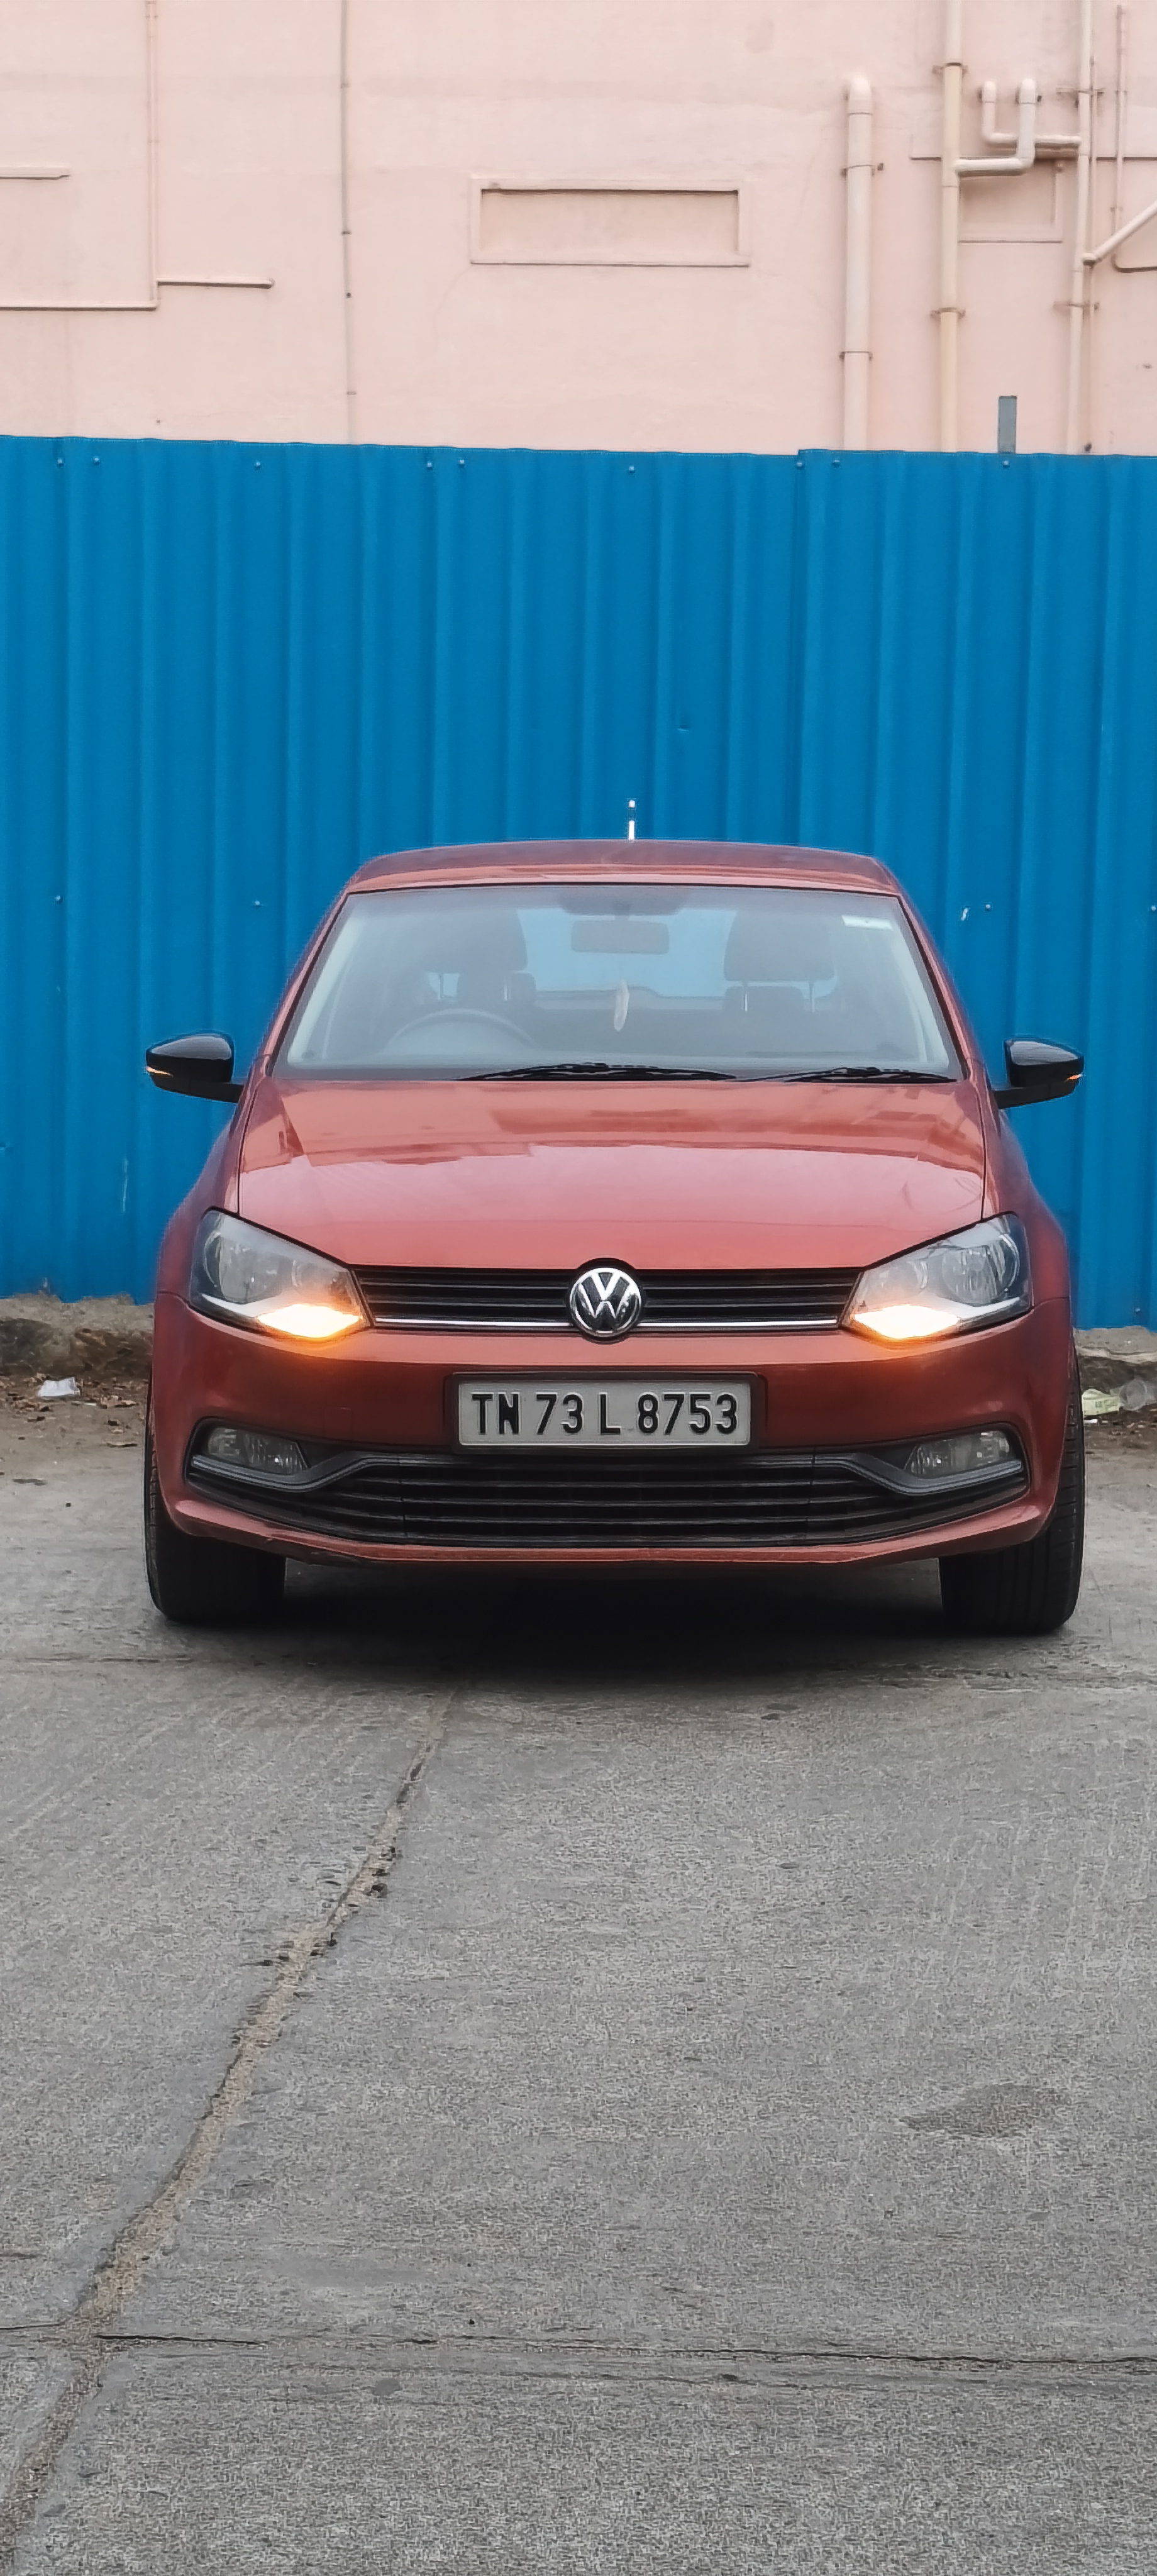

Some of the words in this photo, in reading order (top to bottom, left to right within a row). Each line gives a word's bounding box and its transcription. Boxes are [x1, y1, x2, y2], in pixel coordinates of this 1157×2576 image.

[573, 1269, 638, 1330] VW
[472, 1392, 520, 1435] TN
[536, 1392, 584, 1436] 73
[599, 1392, 621, 1435] L
[638, 1392, 738, 1435] 8753
